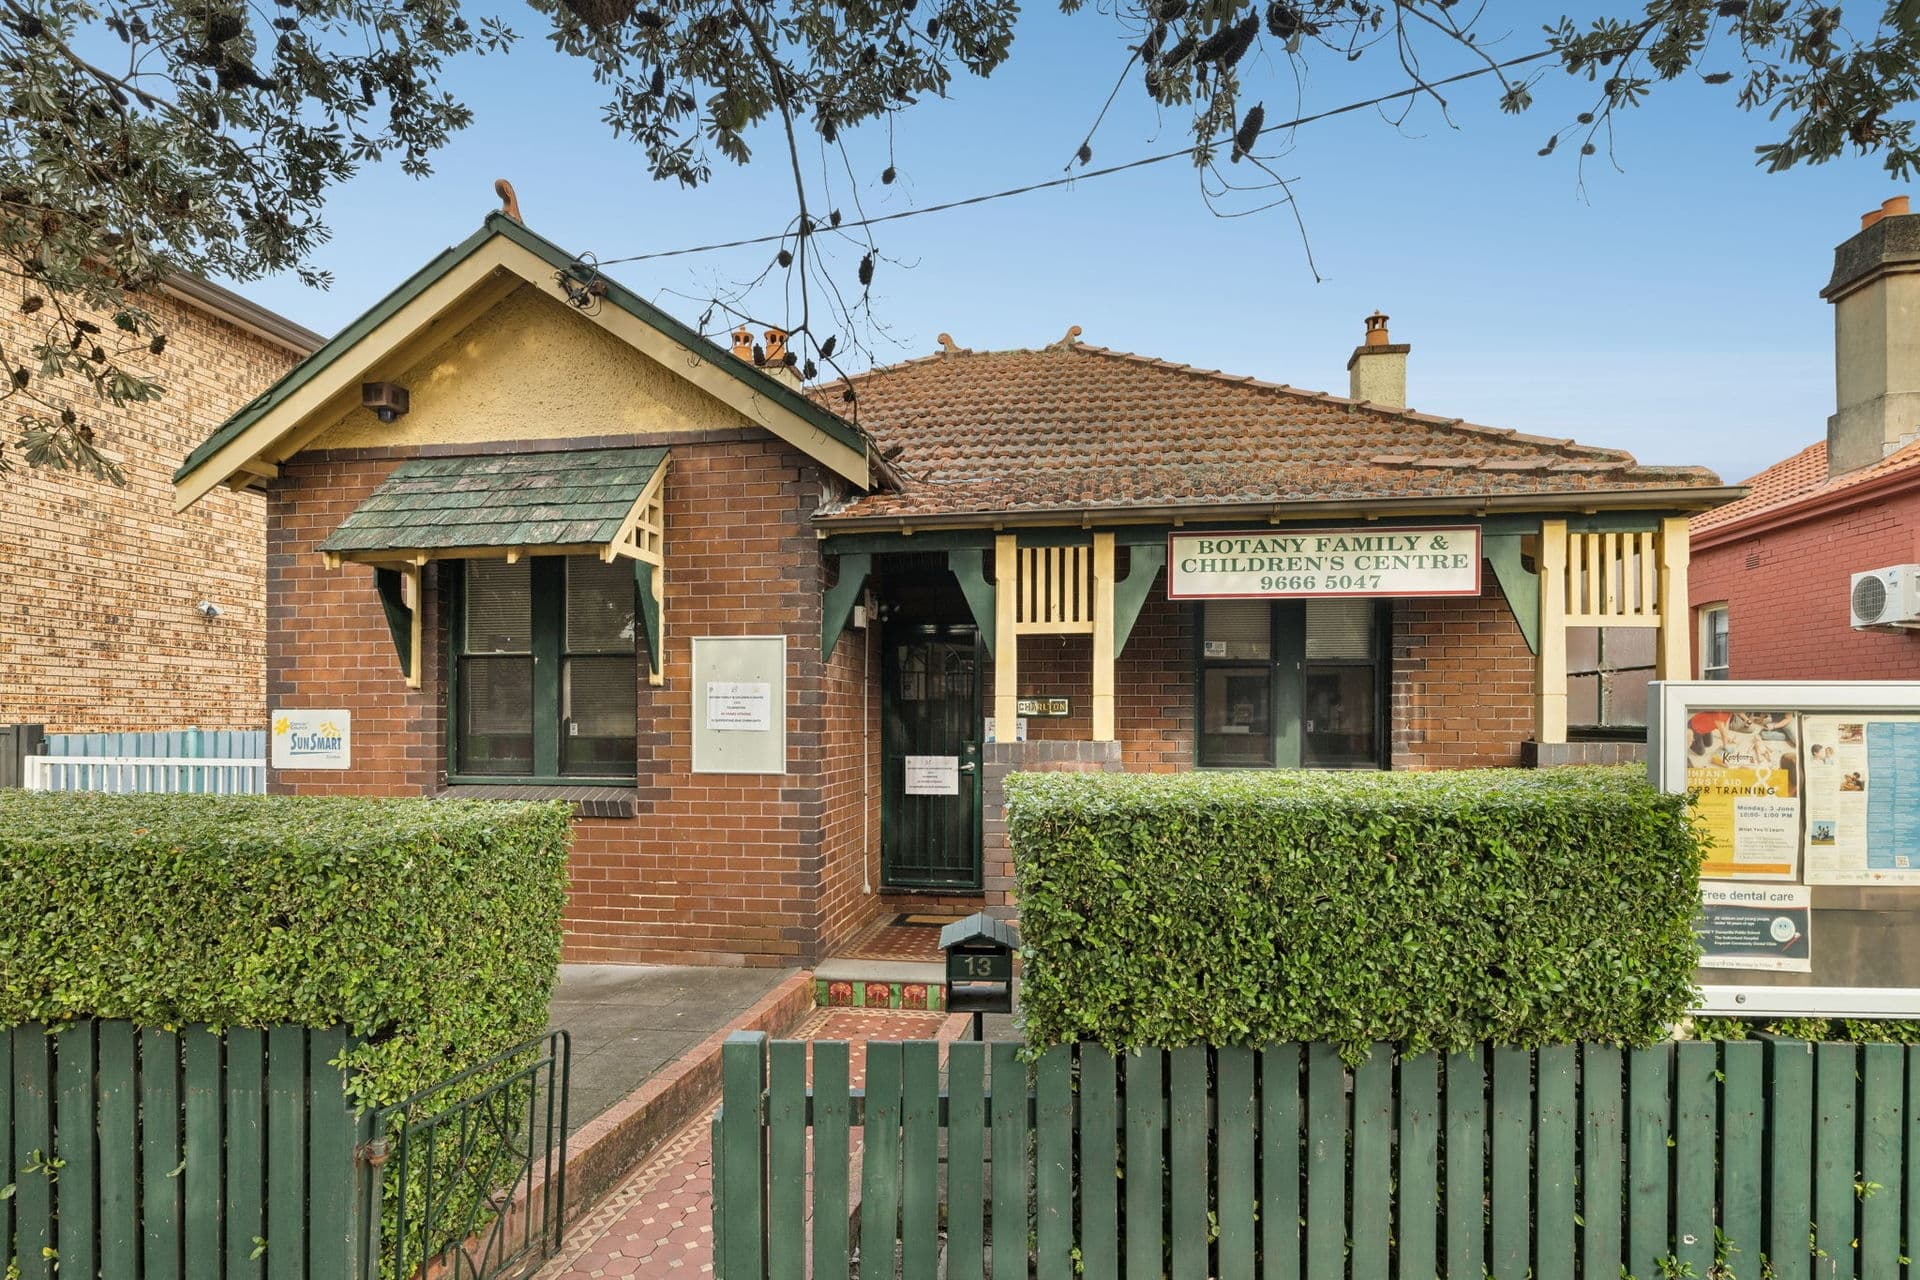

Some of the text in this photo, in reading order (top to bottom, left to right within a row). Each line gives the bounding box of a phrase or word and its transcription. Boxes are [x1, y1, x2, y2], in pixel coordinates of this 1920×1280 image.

[1198, 535, 1449, 555] BOTANY FAMILY &
[1181, 554, 1468, 573] CHILDREN'S CENTRE
[1260, 575, 1382, 591] 9666 5047
[1018, 702, 1066, 712] CHARLTON
[1687, 778, 1718, 786] FIRST
[1687, 786, 1776, 795] CPR TRAINING
[1701, 890, 1794, 901] Free dental care
[964, 957, 992, 976] 13
